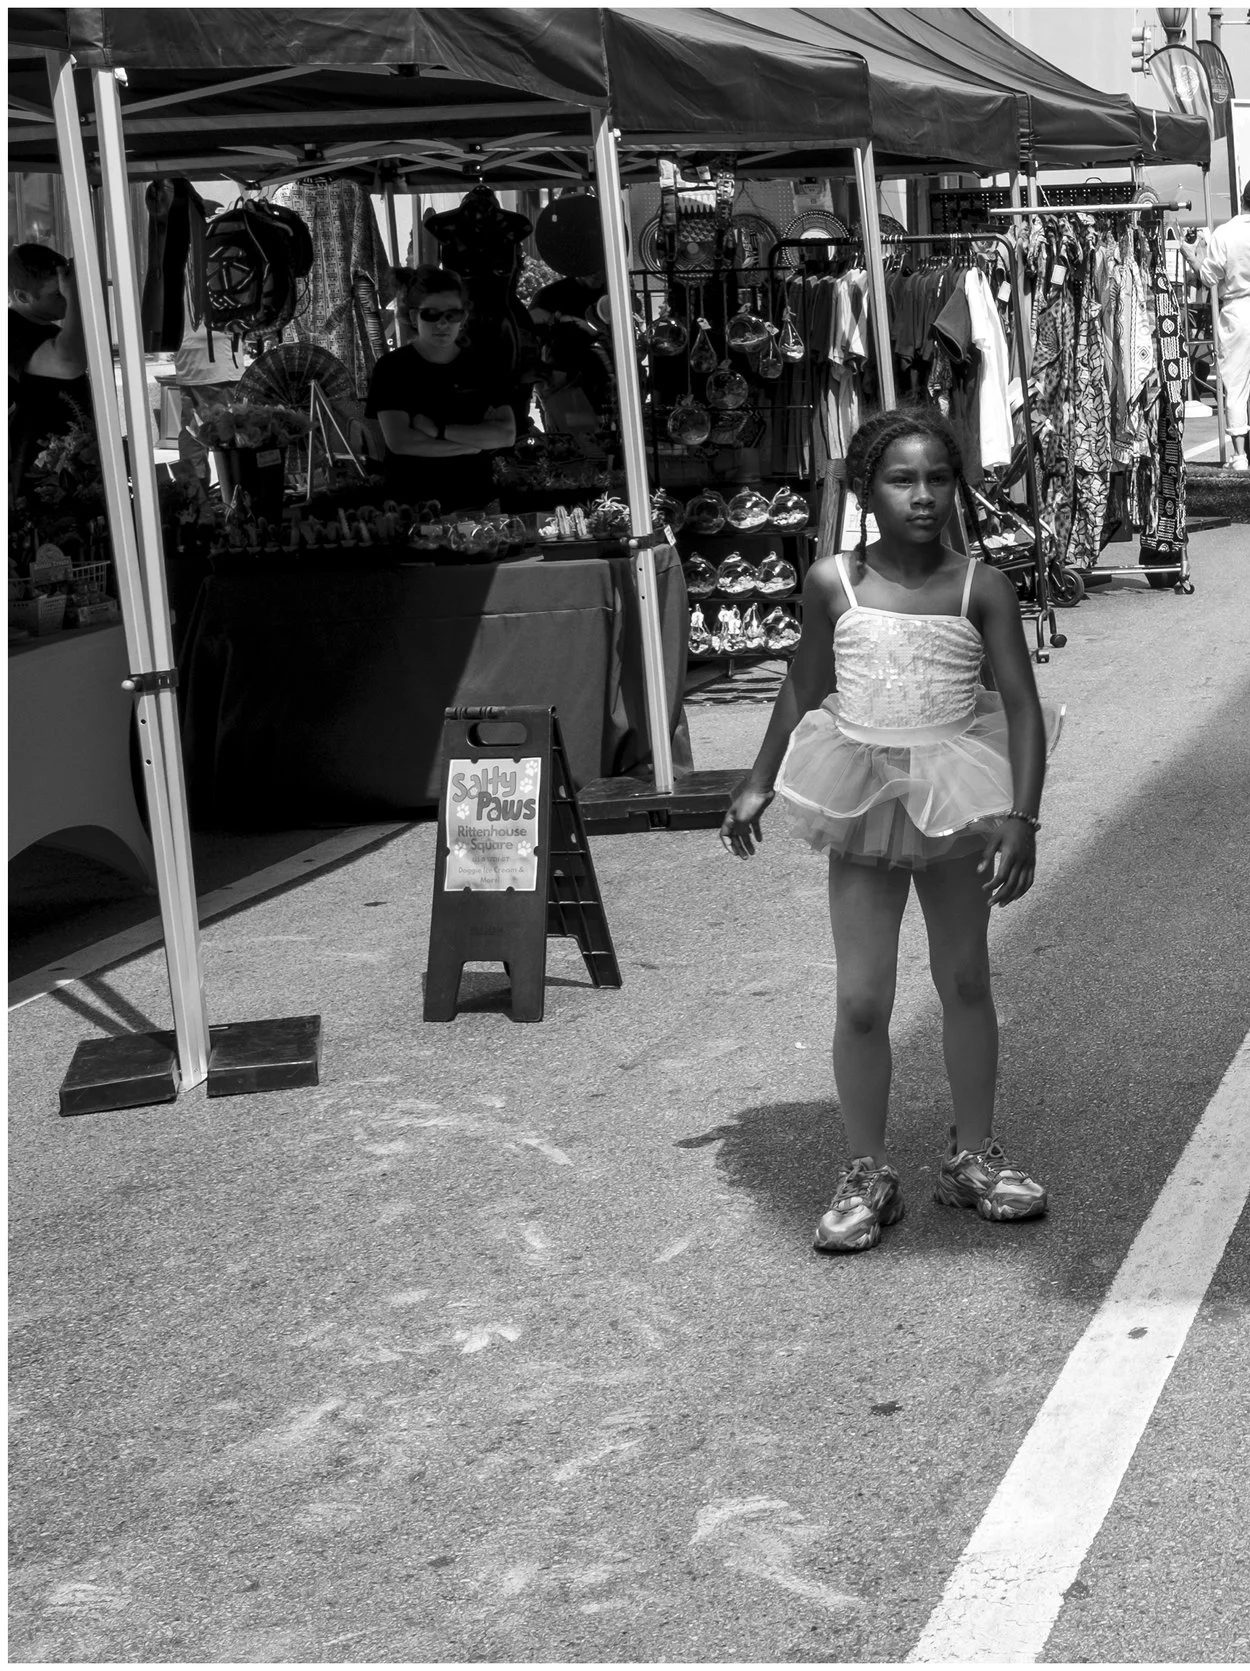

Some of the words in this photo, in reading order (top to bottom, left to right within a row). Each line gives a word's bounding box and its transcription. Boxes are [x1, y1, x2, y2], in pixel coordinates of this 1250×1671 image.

[452, 765, 517, 803] Salty
[476, 791, 537, 822] Paws
[457, 825, 528, 838] Rittenhouse
[470, 838, 514, 853] Square
